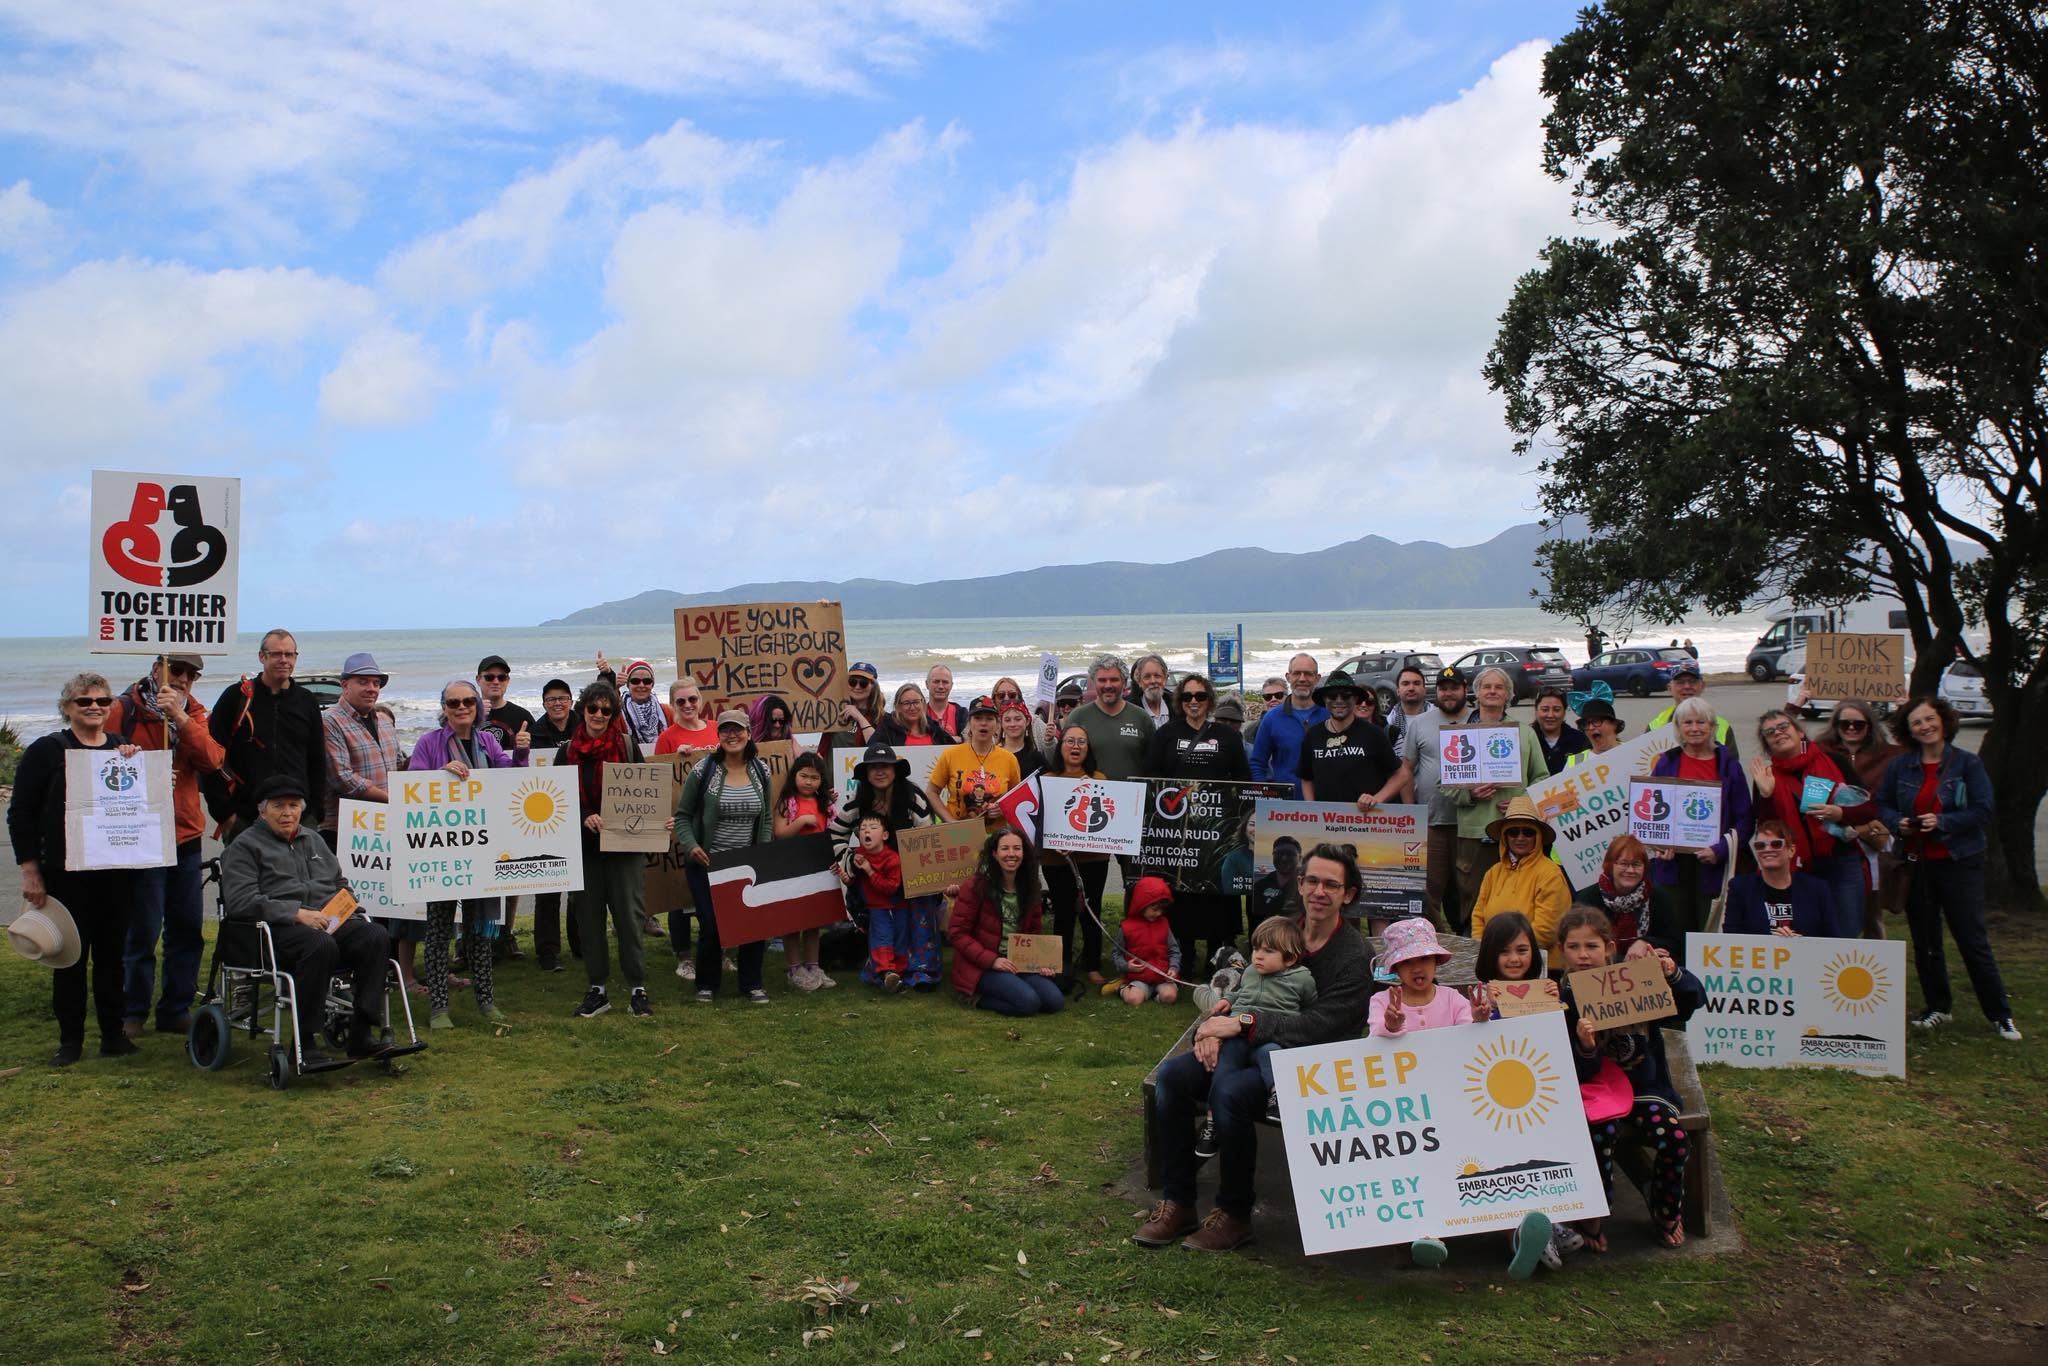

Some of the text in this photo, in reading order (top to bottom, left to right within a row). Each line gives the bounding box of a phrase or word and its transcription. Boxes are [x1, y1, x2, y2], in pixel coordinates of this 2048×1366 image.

[101, 591, 226, 617] TOGETHER
[100, 618, 115, 640] FOR
[121, 619, 225, 643] TE TIRITI
[683, 611, 741, 641] LOVE
[720, 631, 843, 658] NEIGHBOUR
[1820, 637, 1890, 662] HONK
[725, 663, 787, 692] KEEP
[1811, 662, 1895, 675] TO SUPPORT
[1808, 677, 1848, 696] MĀORI
[613, 768, 660, 781] VOTE
[1444, 764, 1477, 772] TOGETHER
[1459, 771, 1477, 779] TIRITI
[404, 781, 483, 804] KEEP
[1191, 790, 1222, 804] PŌTI
[406, 806, 486, 829] MĀORI
[613, 803, 657, 815] WARDS
[1189, 806, 1223, 818] VOTE
[1268, 810, 1416, 828] Jordon Wansbrough
[1633, 822, 1671, 832] TOGETHER
[406, 829, 489, 849] WARDS
[901, 833, 941, 853] VOTE
[1060, 833, 1087, 842] Together,
[1107, 837, 1133, 845] Together
[1141, 827, 1220, 841] EANNA RUDD
[1638, 830, 1670, 840] TE TIRITI
[1071, 841, 1086, 849] keep
[1166, 847, 1200, 857] COAST
[920, 845, 970, 867] KEEP
[1131, 855, 1199, 867] MĀORI WARD
[408, 859, 473, 874] VOTE BY
[495, 863, 538, 871] EMBRACING
[549, 860, 567, 868] TIRITI
[351, 879, 385, 892] VOTE
[409, 874, 473, 889] 11TH OCT
[906, 871, 945, 889] MĀORI
[1013, 935, 1032, 948] Yes
[1703, 945, 1791, 970] KEEP
[1592, 967, 1635, 996] YES
[1704, 971, 1793, 996] MĀORI
[1582, 991, 1672, 1021] MĀORI WARDS
[1705, 997, 1795, 1017] WARDS
[1704, 1027, 1775, 1041] VOTE BY
[1704, 1041, 1776, 1057] 11TH OCT
[1801, 1040, 1886, 1051] EMBRACING TE TIRITI
[1296, 1051, 1418, 1098] KEEP
[1306, 1094, 1432, 1136] MĀORI
[1310, 1127, 1440, 1167] WARDS
[1458, 1167, 1574, 1193] EMBRACING TE TIRITI
[1539, 1181, 1578, 1197] Kāpiti
[1319, 1176, 1421, 1205] VOTE BY
[1325, 1200, 1425, 1229] 11TH OCT
